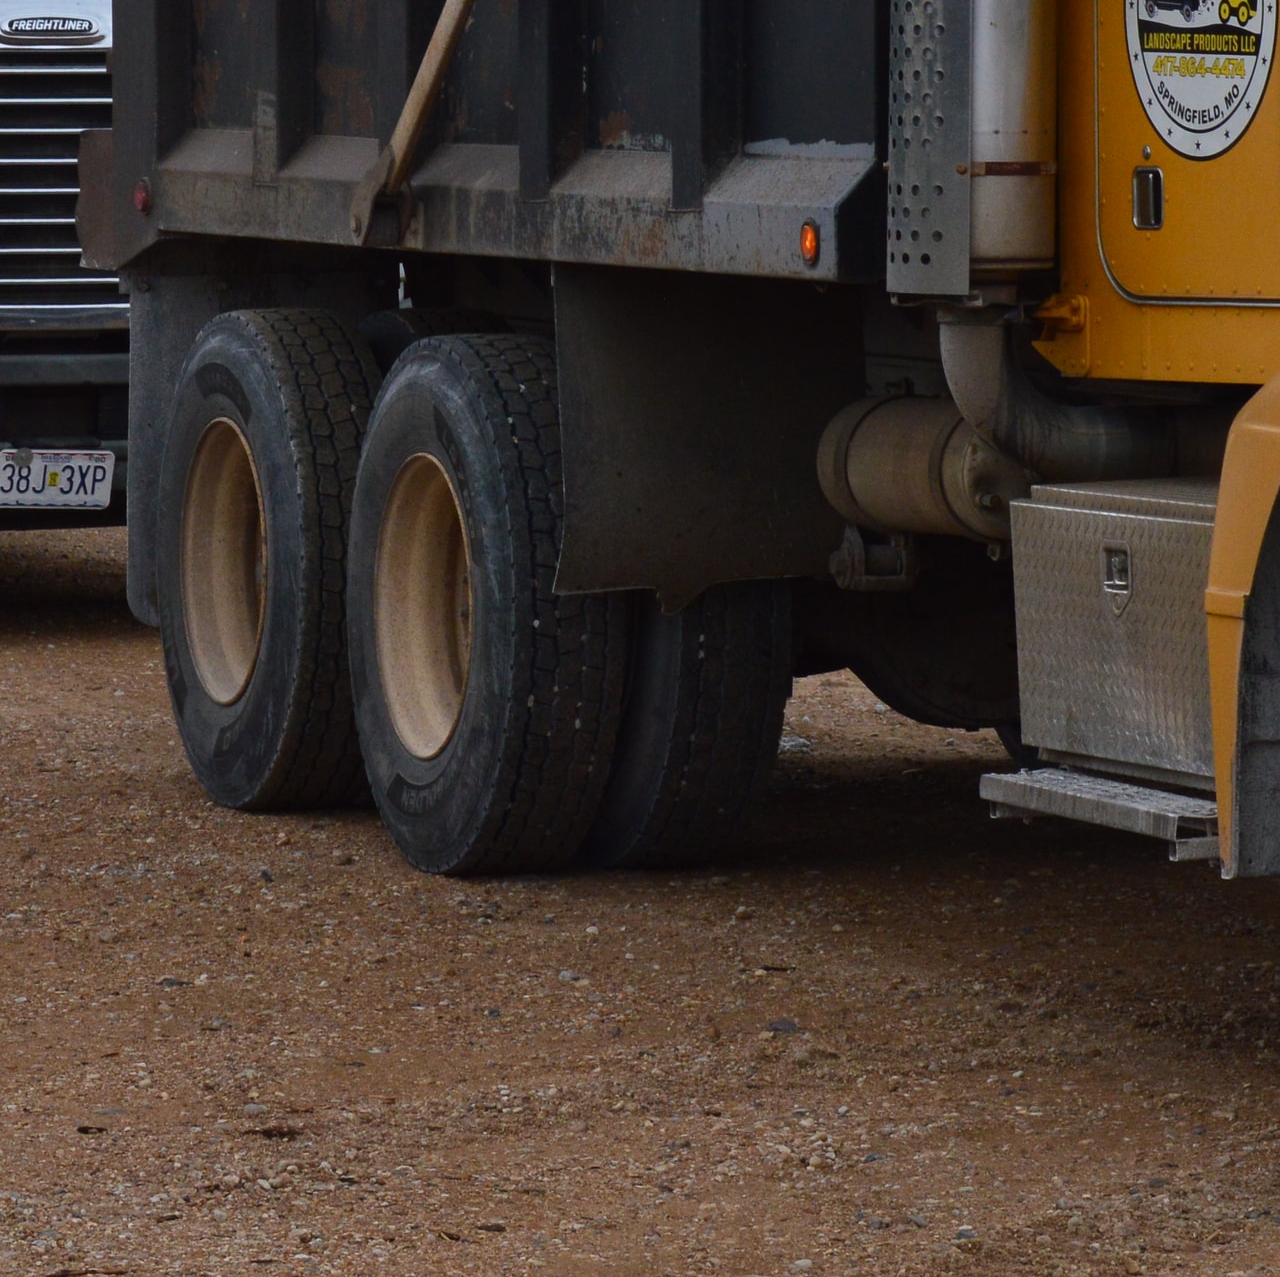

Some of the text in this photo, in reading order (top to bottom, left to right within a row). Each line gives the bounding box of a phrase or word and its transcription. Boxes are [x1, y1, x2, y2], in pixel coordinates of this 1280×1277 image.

[11, 18, 90, 32] FREIGHTLINER
[1144, 32, 1256, 53] LANDSCAPE PRODUCTS LLC
[1152, 55, 1246, 79] 417-864-4474
[1157, 80, 1240, 125] SPRINGFIELD, MO
[0, 463, 48, 494] 38J
[59, 465, 107, 496] 3XP
